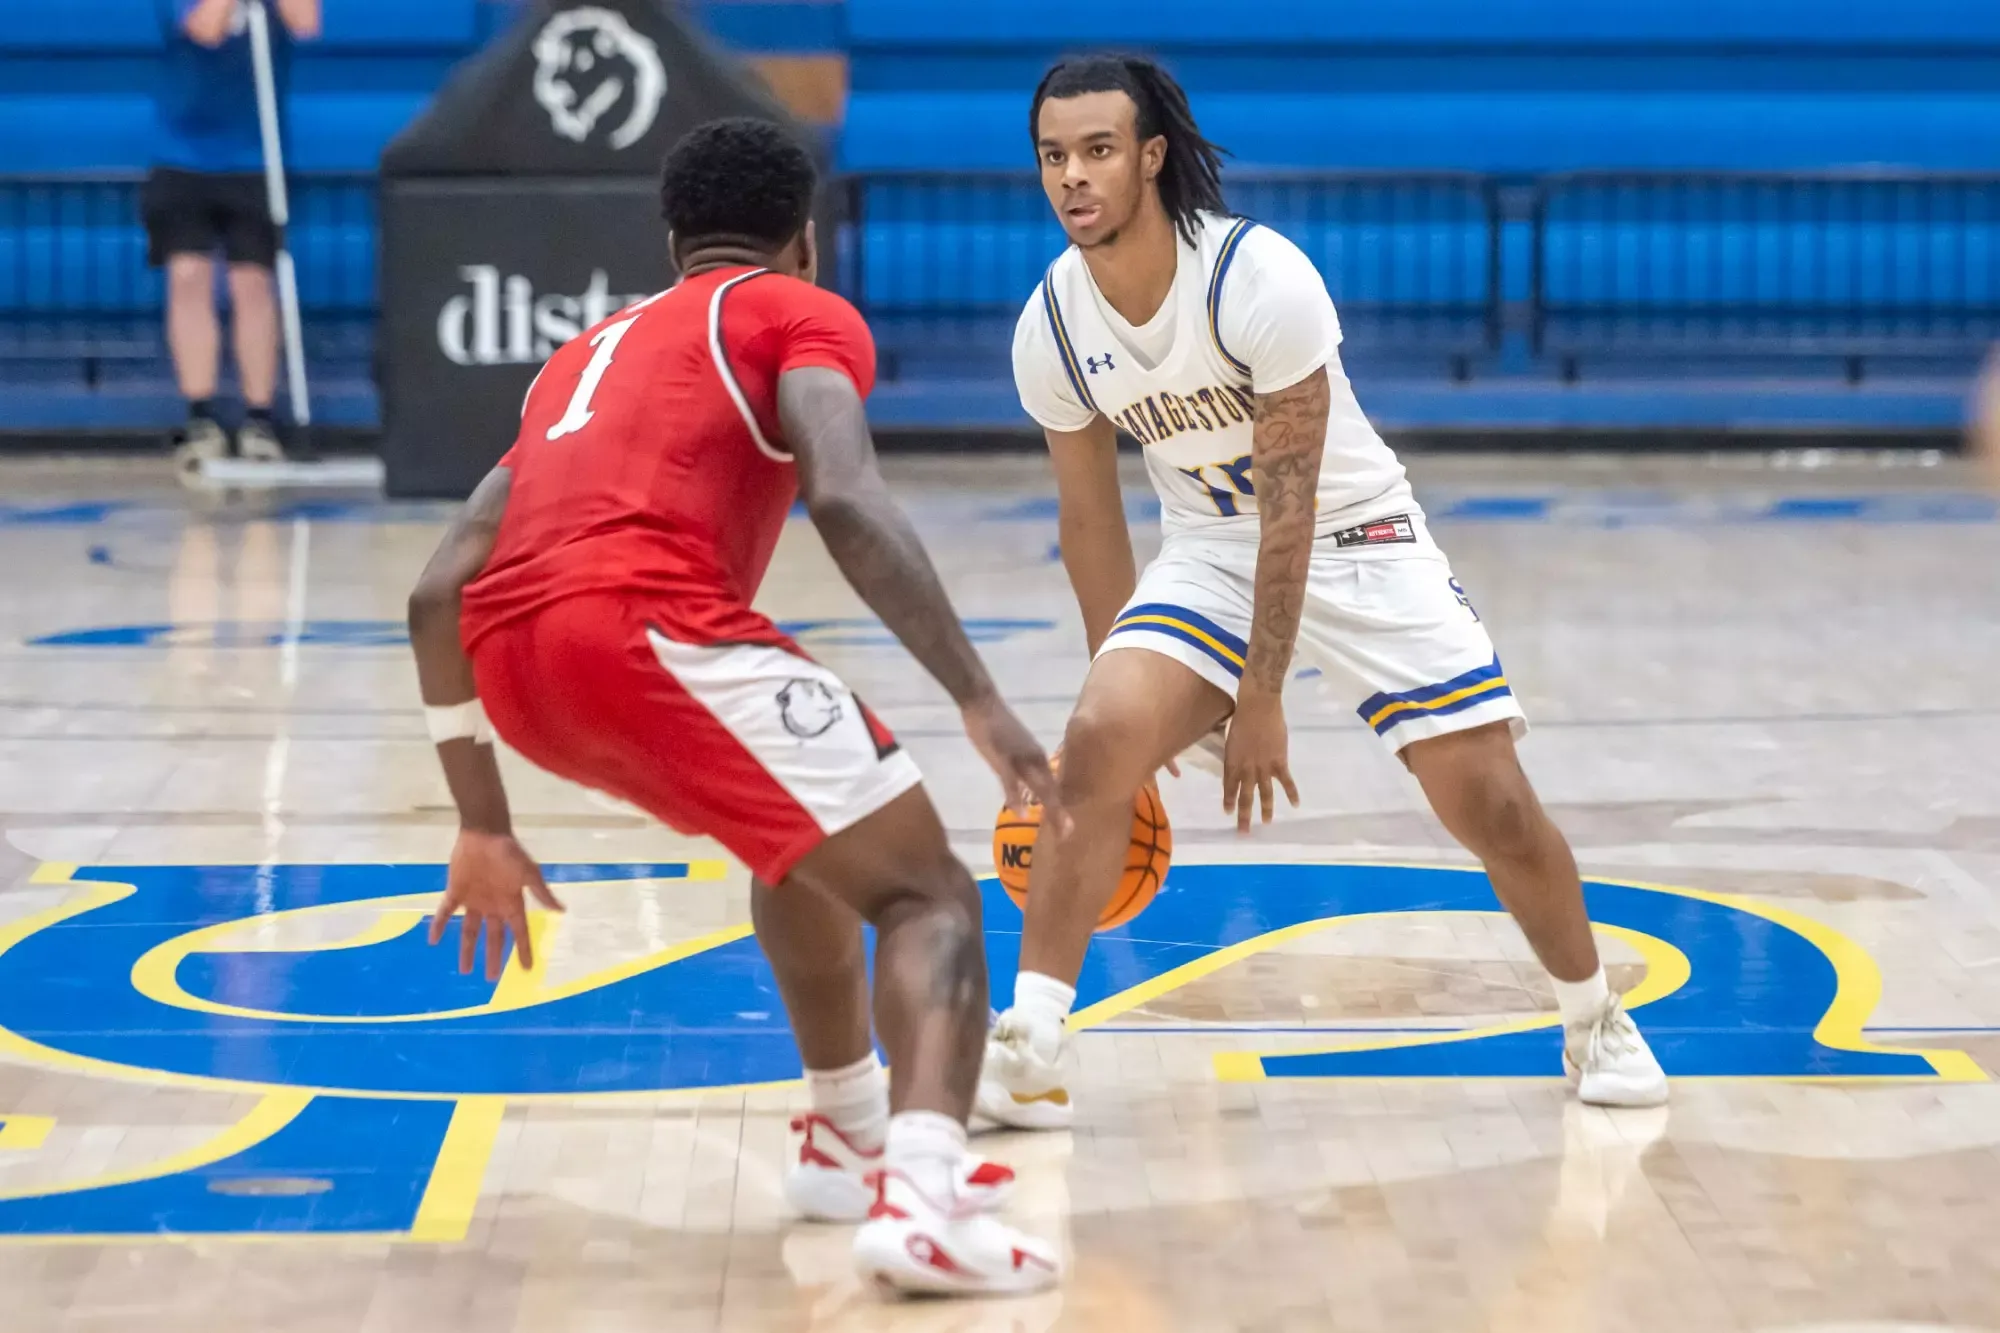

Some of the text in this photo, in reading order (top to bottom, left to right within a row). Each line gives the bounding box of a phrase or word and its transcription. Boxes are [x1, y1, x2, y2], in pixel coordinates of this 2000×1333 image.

[437, 264, 649, 366] dist
[546, 312, 643, 440] 1
[1002, 843, 1033, 869] NC
